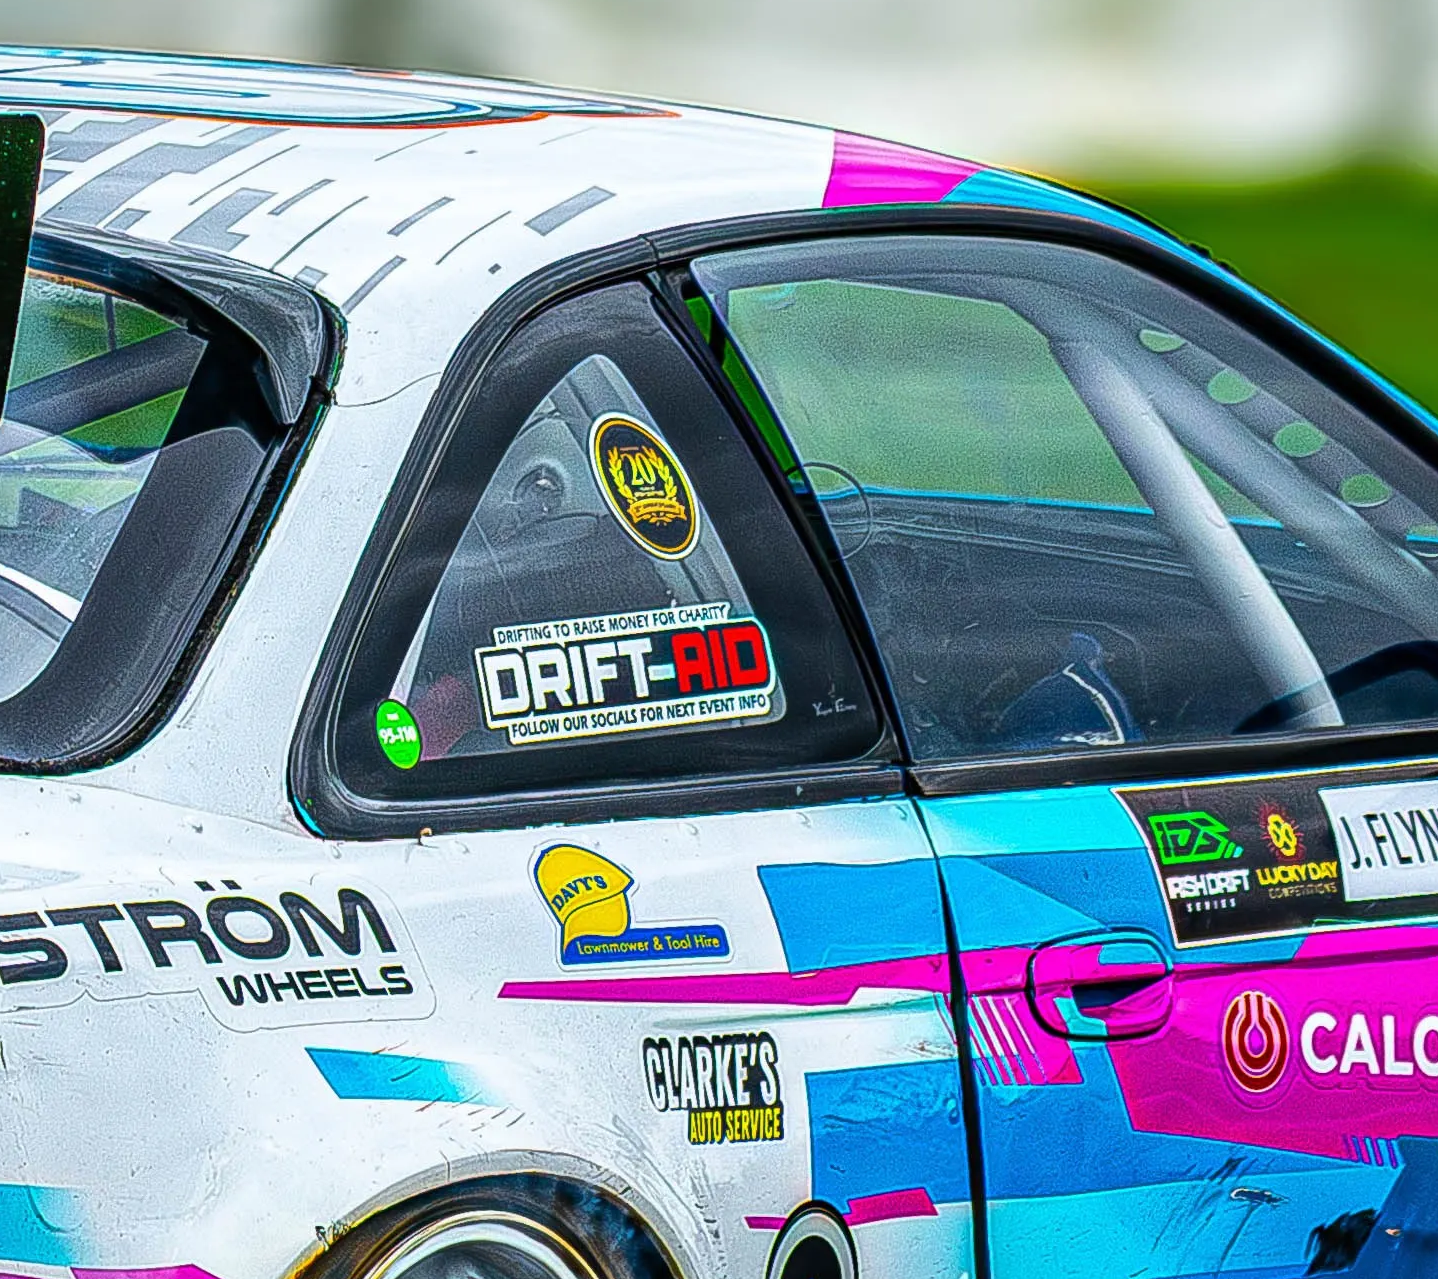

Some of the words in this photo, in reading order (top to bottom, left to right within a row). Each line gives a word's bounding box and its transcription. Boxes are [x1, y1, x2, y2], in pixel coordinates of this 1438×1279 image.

[497, 625, 552, 645] DRIFTING
[554, 623, 570, 639] TO
[574, 619, 607, 635] RAISE
[609, 614, 650, 632] MONEY
[652, 610, 675, 626] FOR
[678, 604, 727, 623] CHARITY
[483, 624, 770, 716] DRIFT-AID
[511, 719, 560, 738] FOLLOW
[564, 715, 589, 732] OUR
[591, 709, 638, 730] SOCIALS
[640, 707, 664, 724] FOR
[666, 702, 697, 720] NEXT
[699, 698, 736, 716] EVENT
[738, 694, 767, 711] INFO
[1307, 860, 1339, 881] DAY
[551, 874, 608, 912] DAVY'S
[1186, 897, 1237, 914] SERIES
[576, 938, 649, 955] Lawnmower
[653, 935, 663, 951] &
[664, 934, 691, 950] Tool
[693, 933, 721, 949] Hire
[216, 965, 413, 1007] WHEELS
[645, 1040, 778, 1111] CLARKE'S
[690, 1110, 722, 1142] AUTO
[725, 1107, 781, 1141] SERVICE
